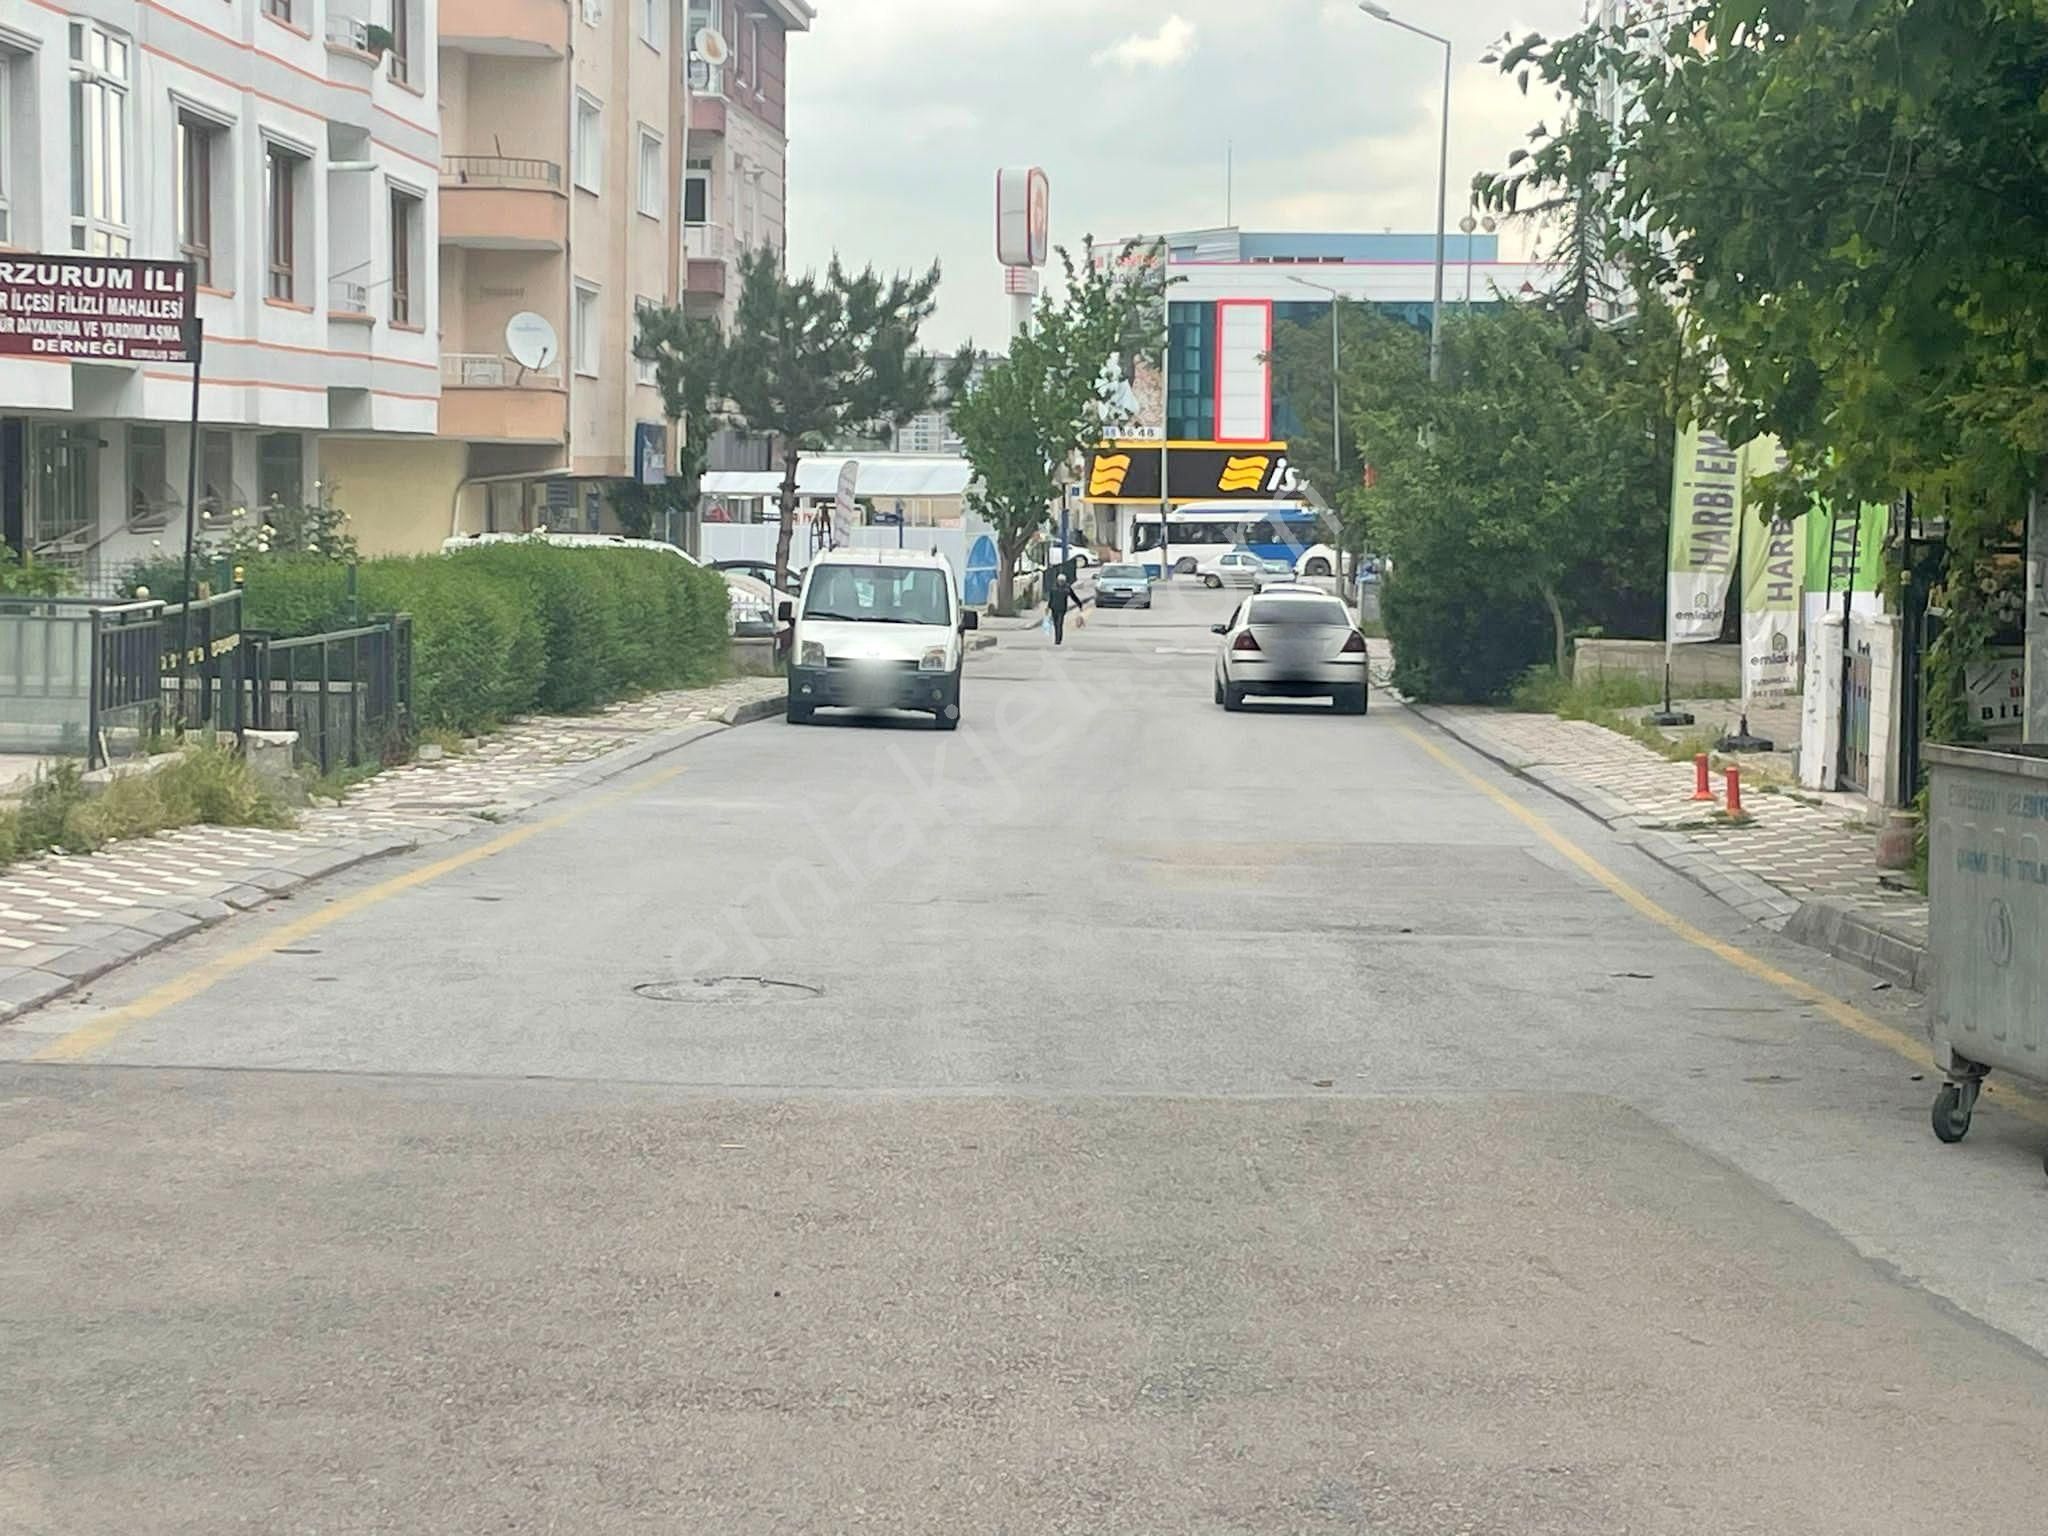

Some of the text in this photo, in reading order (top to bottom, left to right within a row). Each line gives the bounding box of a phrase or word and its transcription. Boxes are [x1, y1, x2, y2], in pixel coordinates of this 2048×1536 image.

[144, 266, 185, 293] İLİ
[11, 288, 55, 316] İLÇESİ
[58, 291, 104, 316] FİLİZLİ
[107, 297, 184, 320] MAHALLESİ
[17, 317, 81, 339] DAYANIŞMA
[83, 321, 99, 337] VE
[101, 323, 181, 345] YARDIMLAŞMA
[32, 338, 125, 356] DERNEĞİ
[1683, 481, 1735, 574] HARBİ
